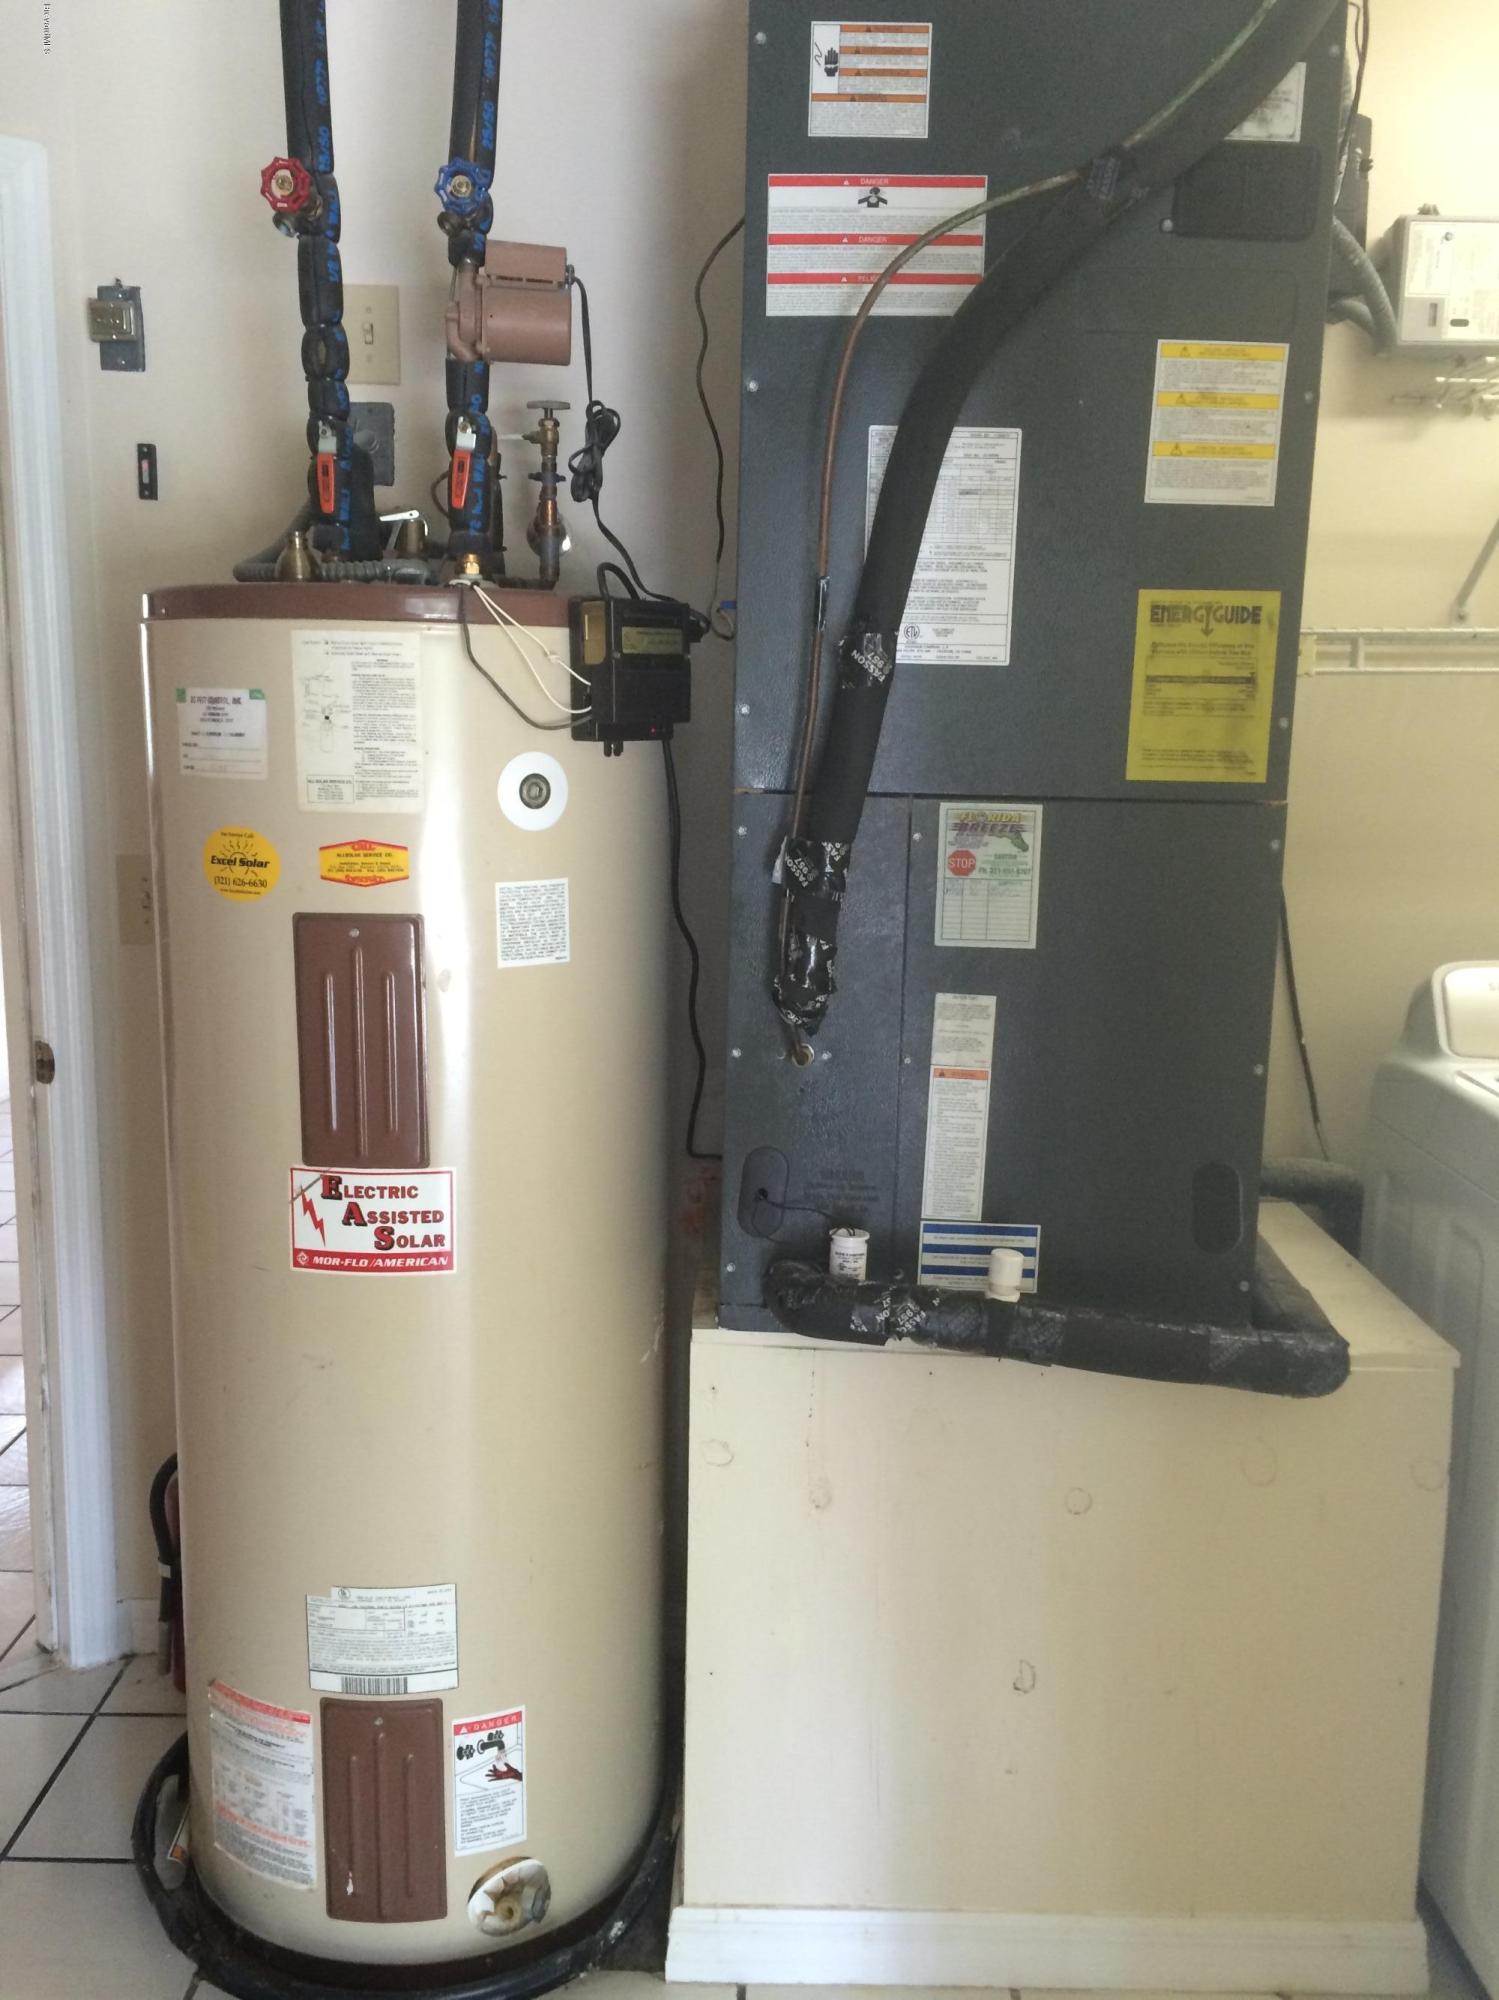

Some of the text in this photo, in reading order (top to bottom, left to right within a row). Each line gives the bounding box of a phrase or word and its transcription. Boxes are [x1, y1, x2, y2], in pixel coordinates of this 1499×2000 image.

[860, 177, 889, 185] DANGER
[210, 855, 271, 868] Excel Solar
[948, 858, 976, 869] STOP
[214, 875, 231, 887] (321)
[320, 1174, 419, 1201] ELECTRIC
[341, 1201, 445, 1227] ASSISTED
[373, 1225, 446, 1251] SOLAR
[473, 1716, 519, 1732] DANGER
